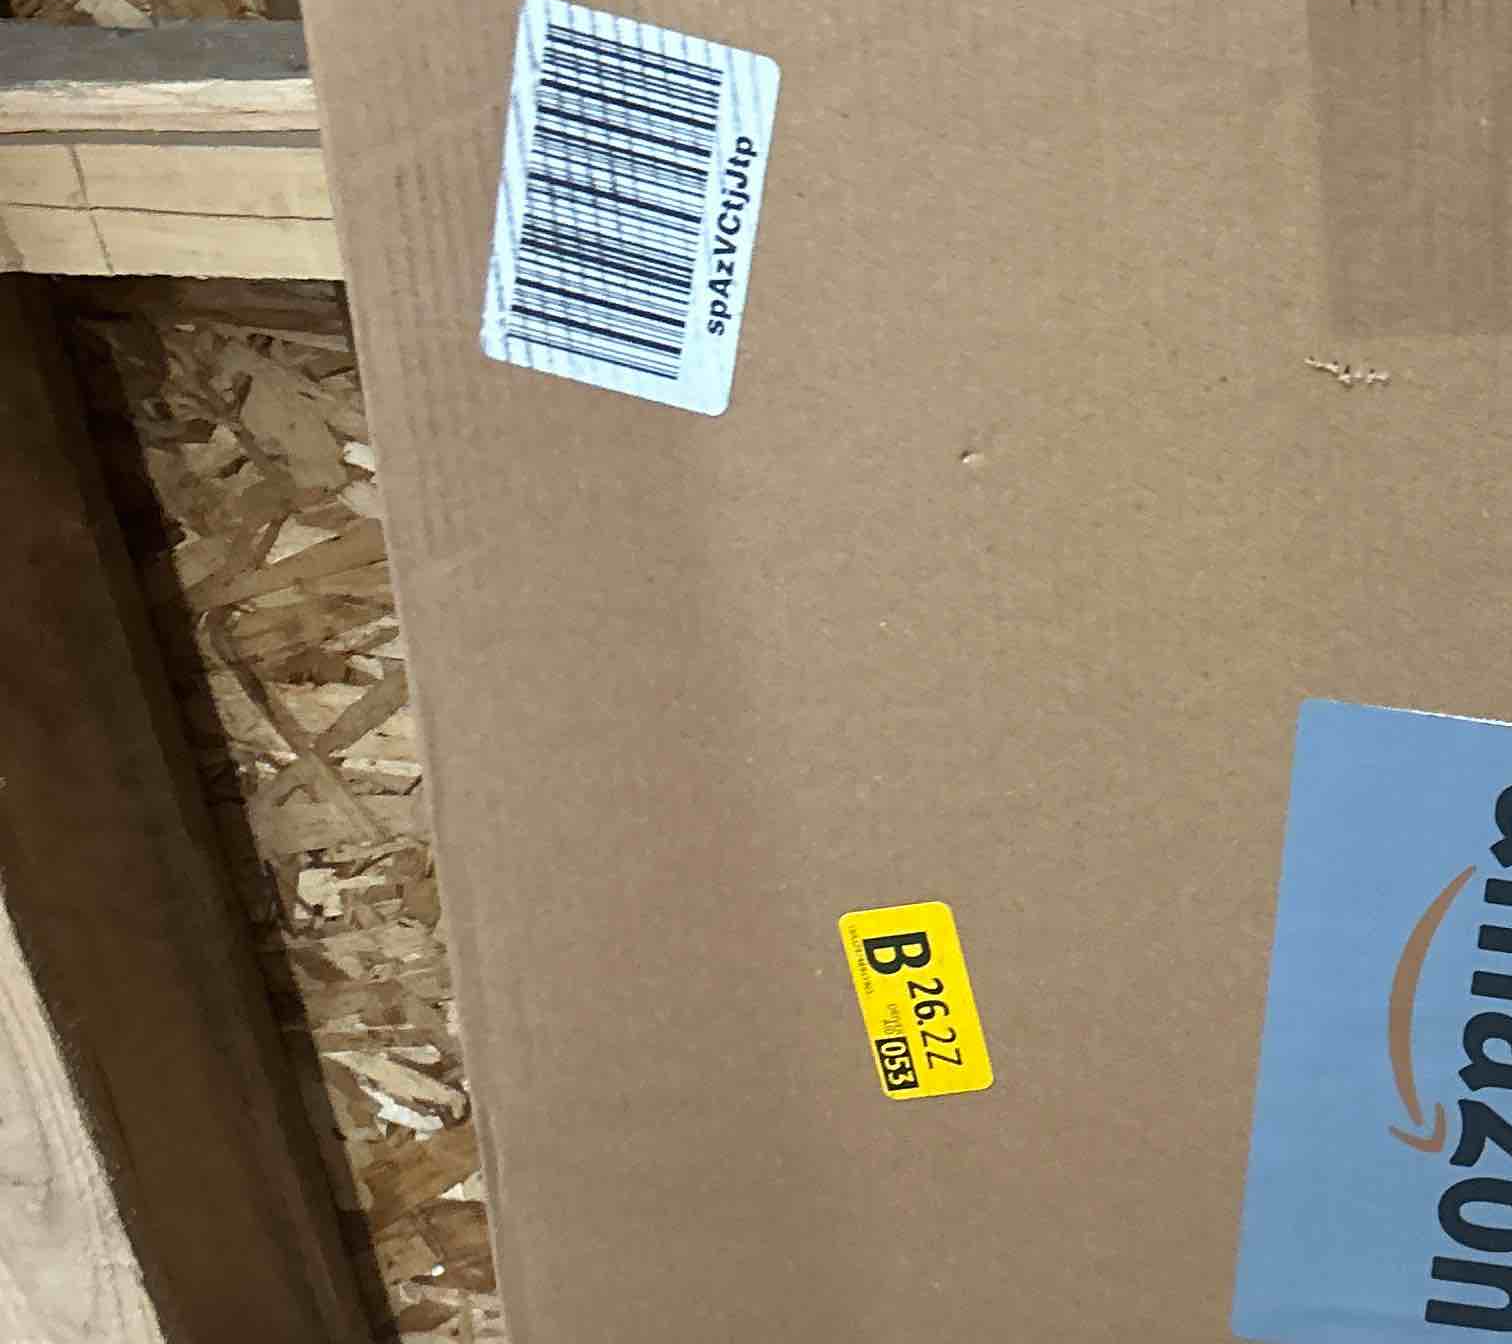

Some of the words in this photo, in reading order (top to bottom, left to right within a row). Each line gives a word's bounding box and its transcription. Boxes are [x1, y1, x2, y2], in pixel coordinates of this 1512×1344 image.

[707, 136, 758, 336] spAzVCtjJtp
[863, 931, 931, 975] B
[880, 1041, 915, 1086] 053
